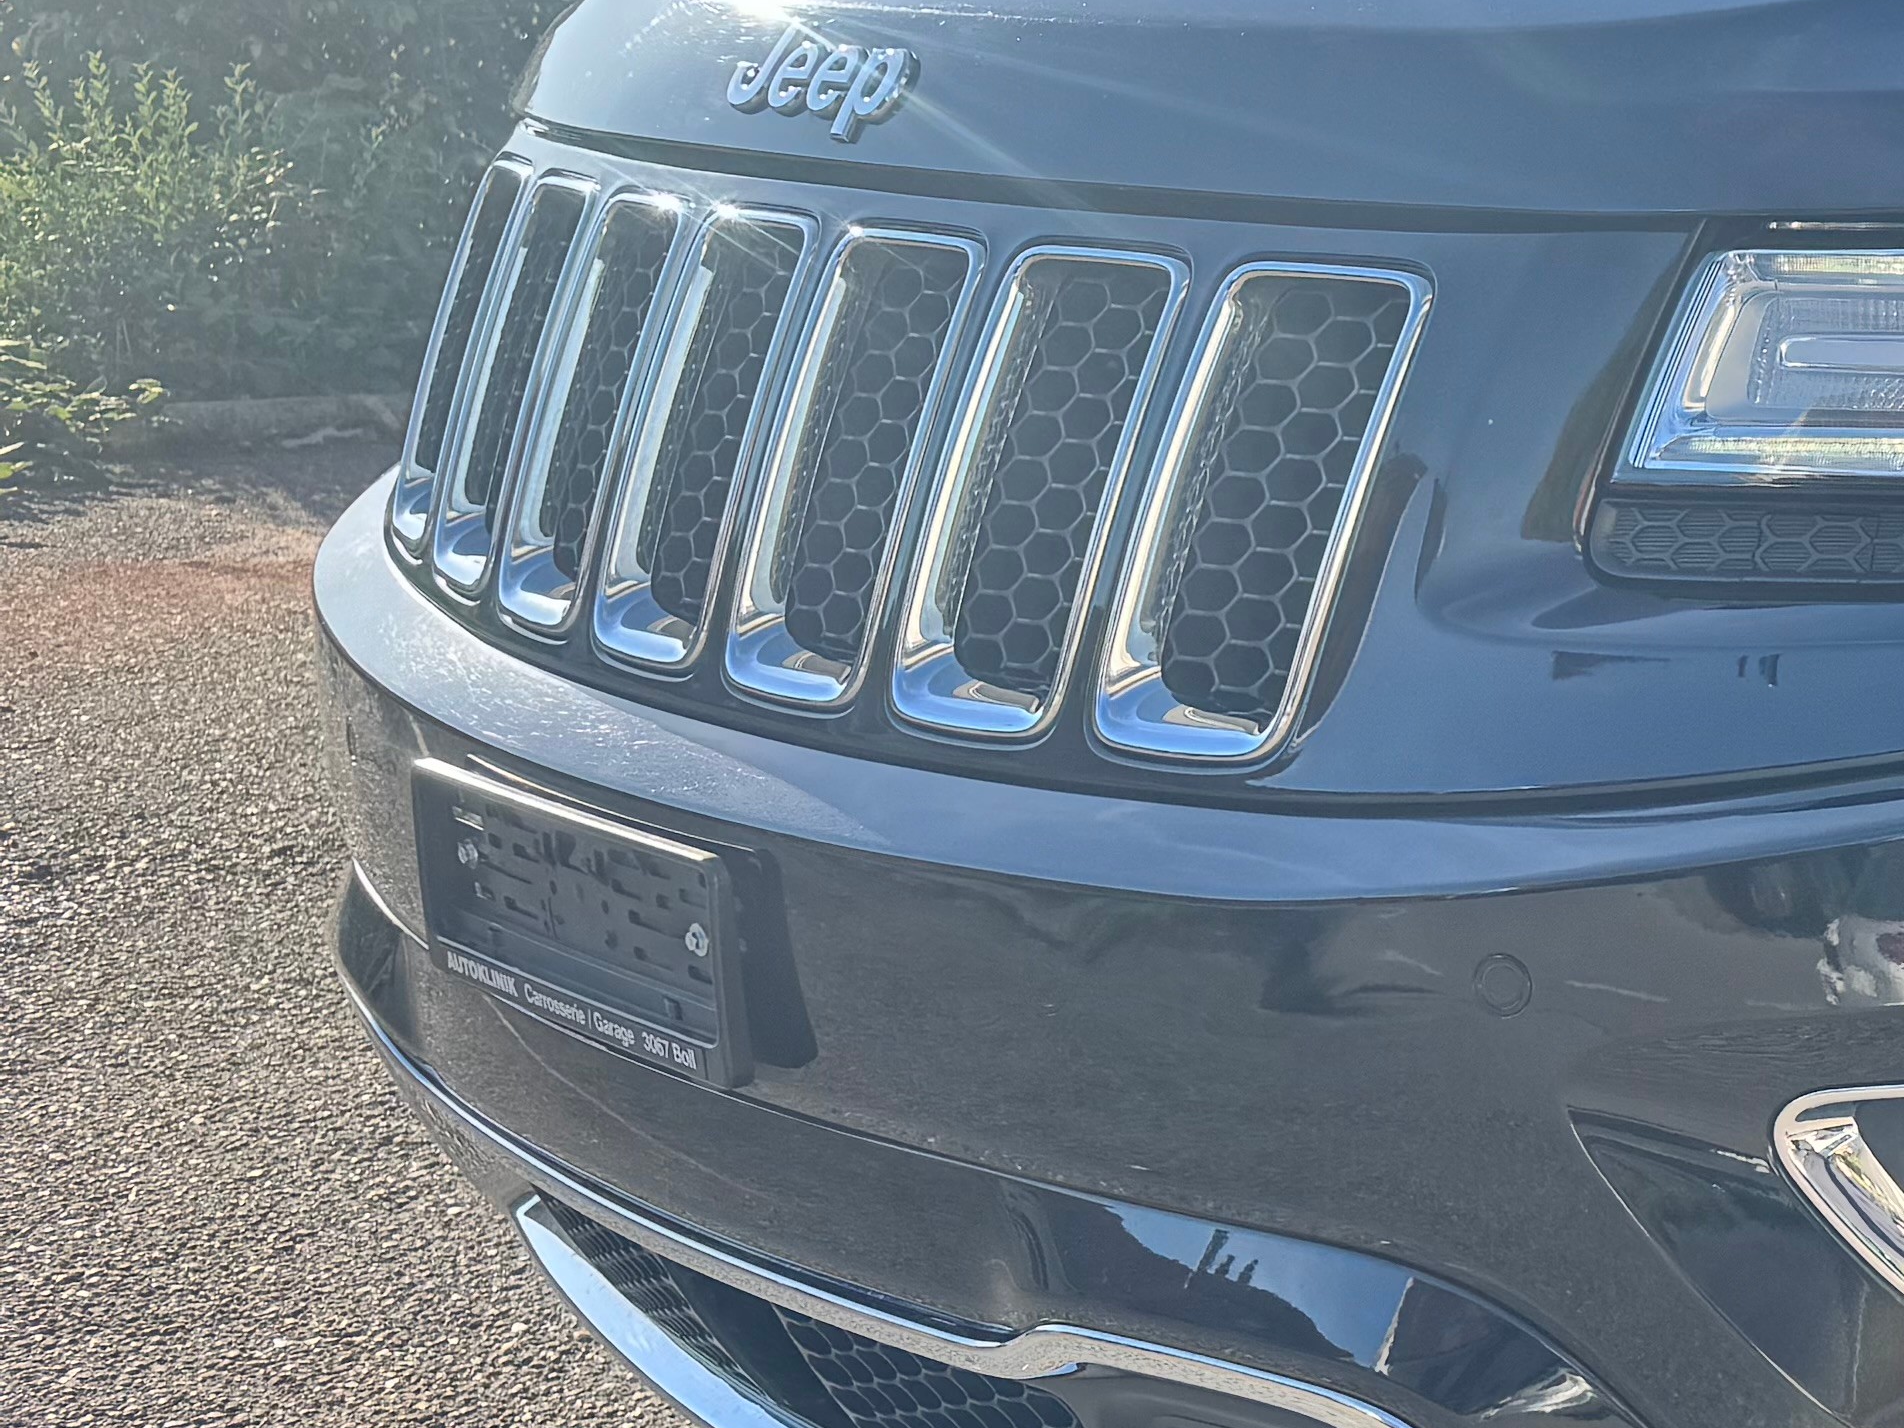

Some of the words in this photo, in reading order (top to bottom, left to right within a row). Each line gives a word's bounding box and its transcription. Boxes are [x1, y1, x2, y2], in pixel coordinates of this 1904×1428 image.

[727, 22, 920, 142] Jeep
[446, 950, 519, 998] AUTOKLINIK
[523, 982, 586, 1026] Carrosserie
[593, 1011, 636, 1047] Garage
[641, 1031, 670, 1059] 3067
[672, 1043, 697, 1070] Boll
